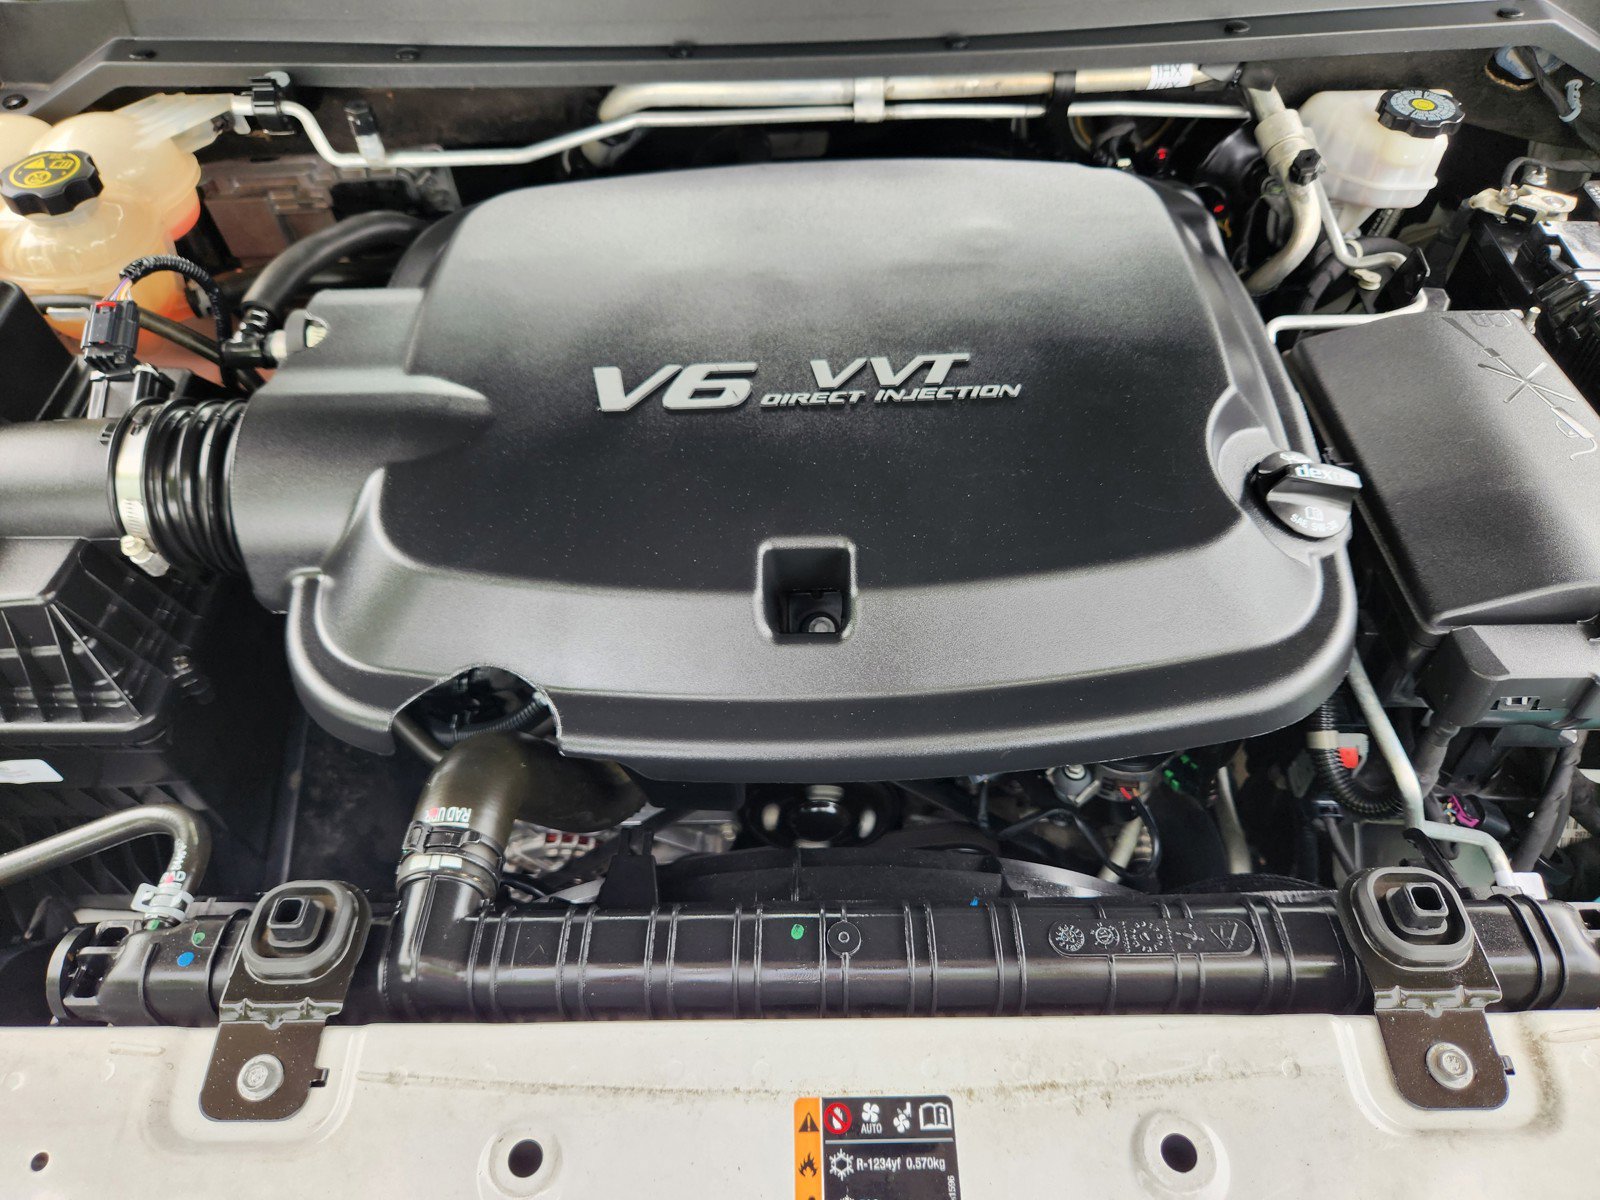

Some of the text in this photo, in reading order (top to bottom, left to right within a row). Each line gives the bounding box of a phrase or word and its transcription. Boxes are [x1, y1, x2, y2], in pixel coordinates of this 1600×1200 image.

[810, 352, 971, 389] VVT
[593, 361, 758, 412] V6
[760, 383, 1022, 408] DIRECT INJECTION
[447, 806, 472, 823] RAD
[861, 1123, 882, 1134] AUTO
[856, 1156, 945, 1171] R-1234yf 0.570kg
